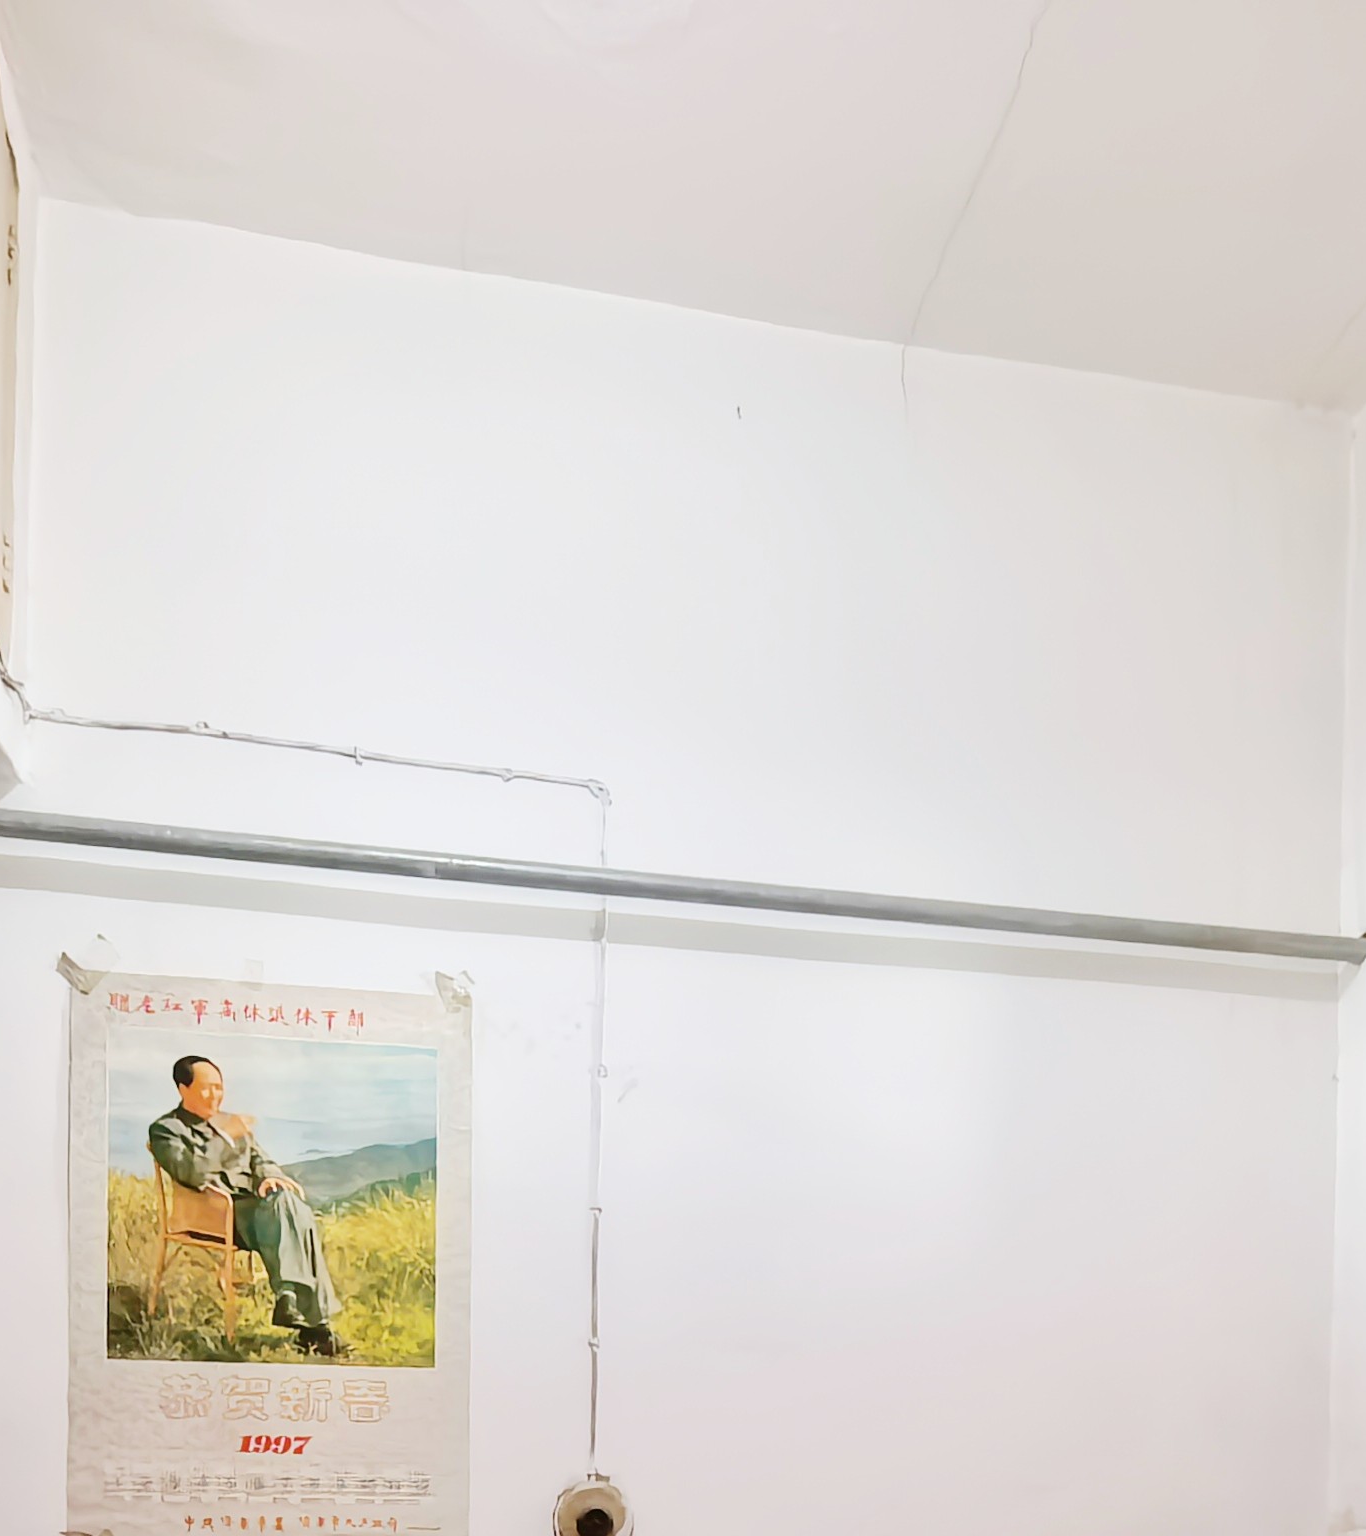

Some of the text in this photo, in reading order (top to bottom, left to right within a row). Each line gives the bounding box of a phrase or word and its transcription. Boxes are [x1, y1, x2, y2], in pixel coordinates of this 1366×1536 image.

[158, 1373, 391, 1423] 恭贺新春
[236, 1434, 314, 1456] 1997
